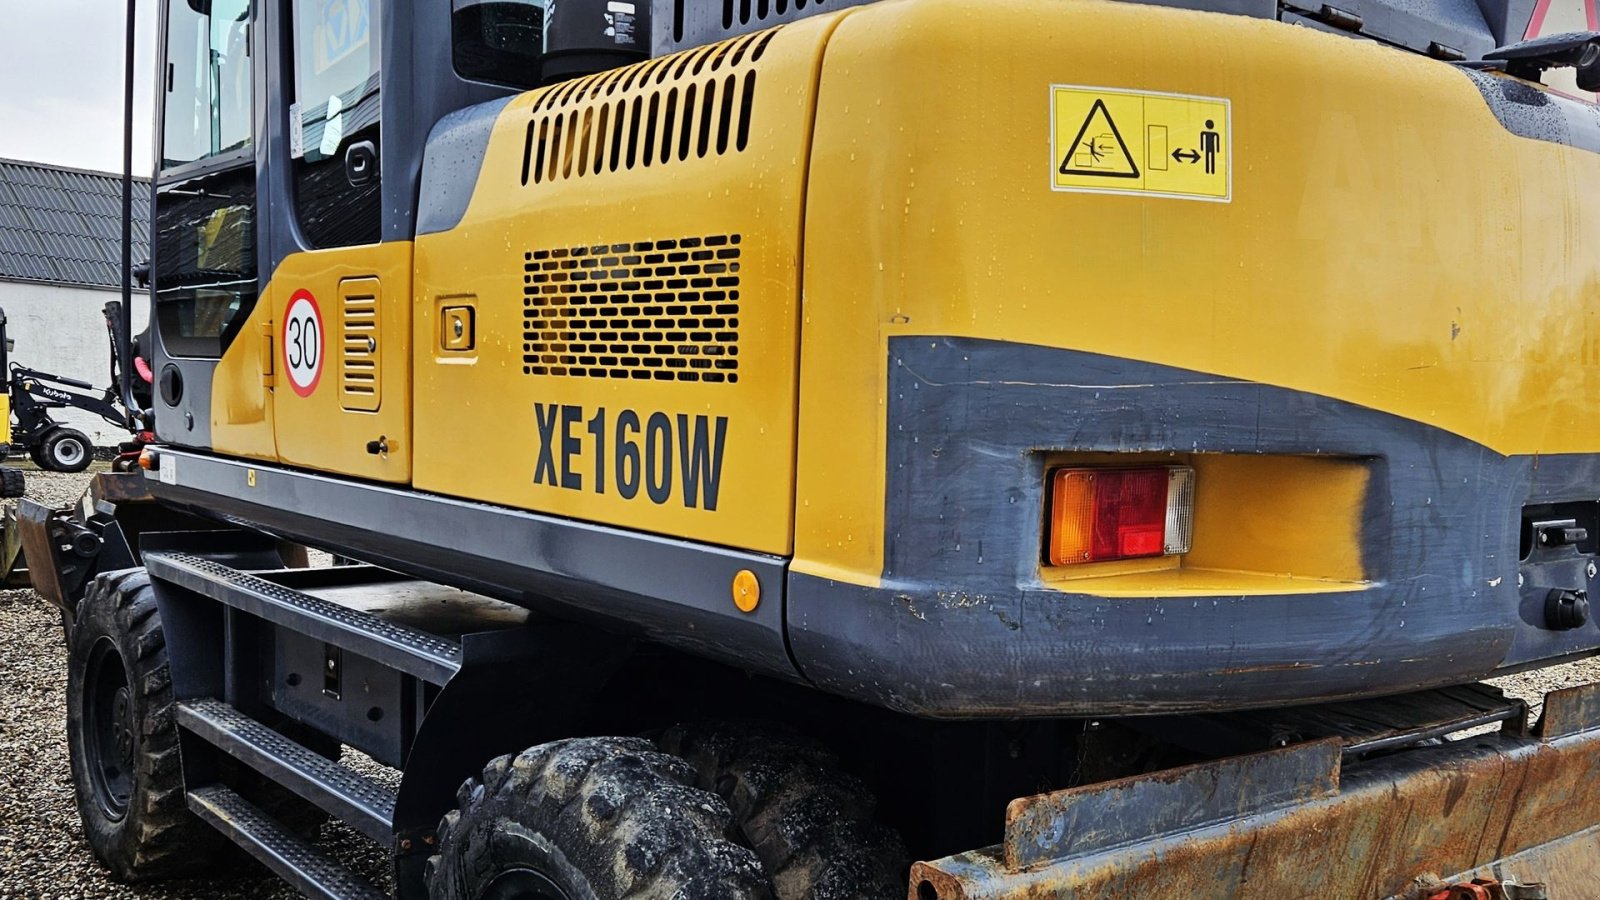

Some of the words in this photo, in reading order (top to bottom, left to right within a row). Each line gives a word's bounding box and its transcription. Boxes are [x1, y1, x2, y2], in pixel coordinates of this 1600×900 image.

[289, 317, 317, 369] 30
[43, 388, 72, 400] Kubota
[533, 402, 728, 512] XE160W
